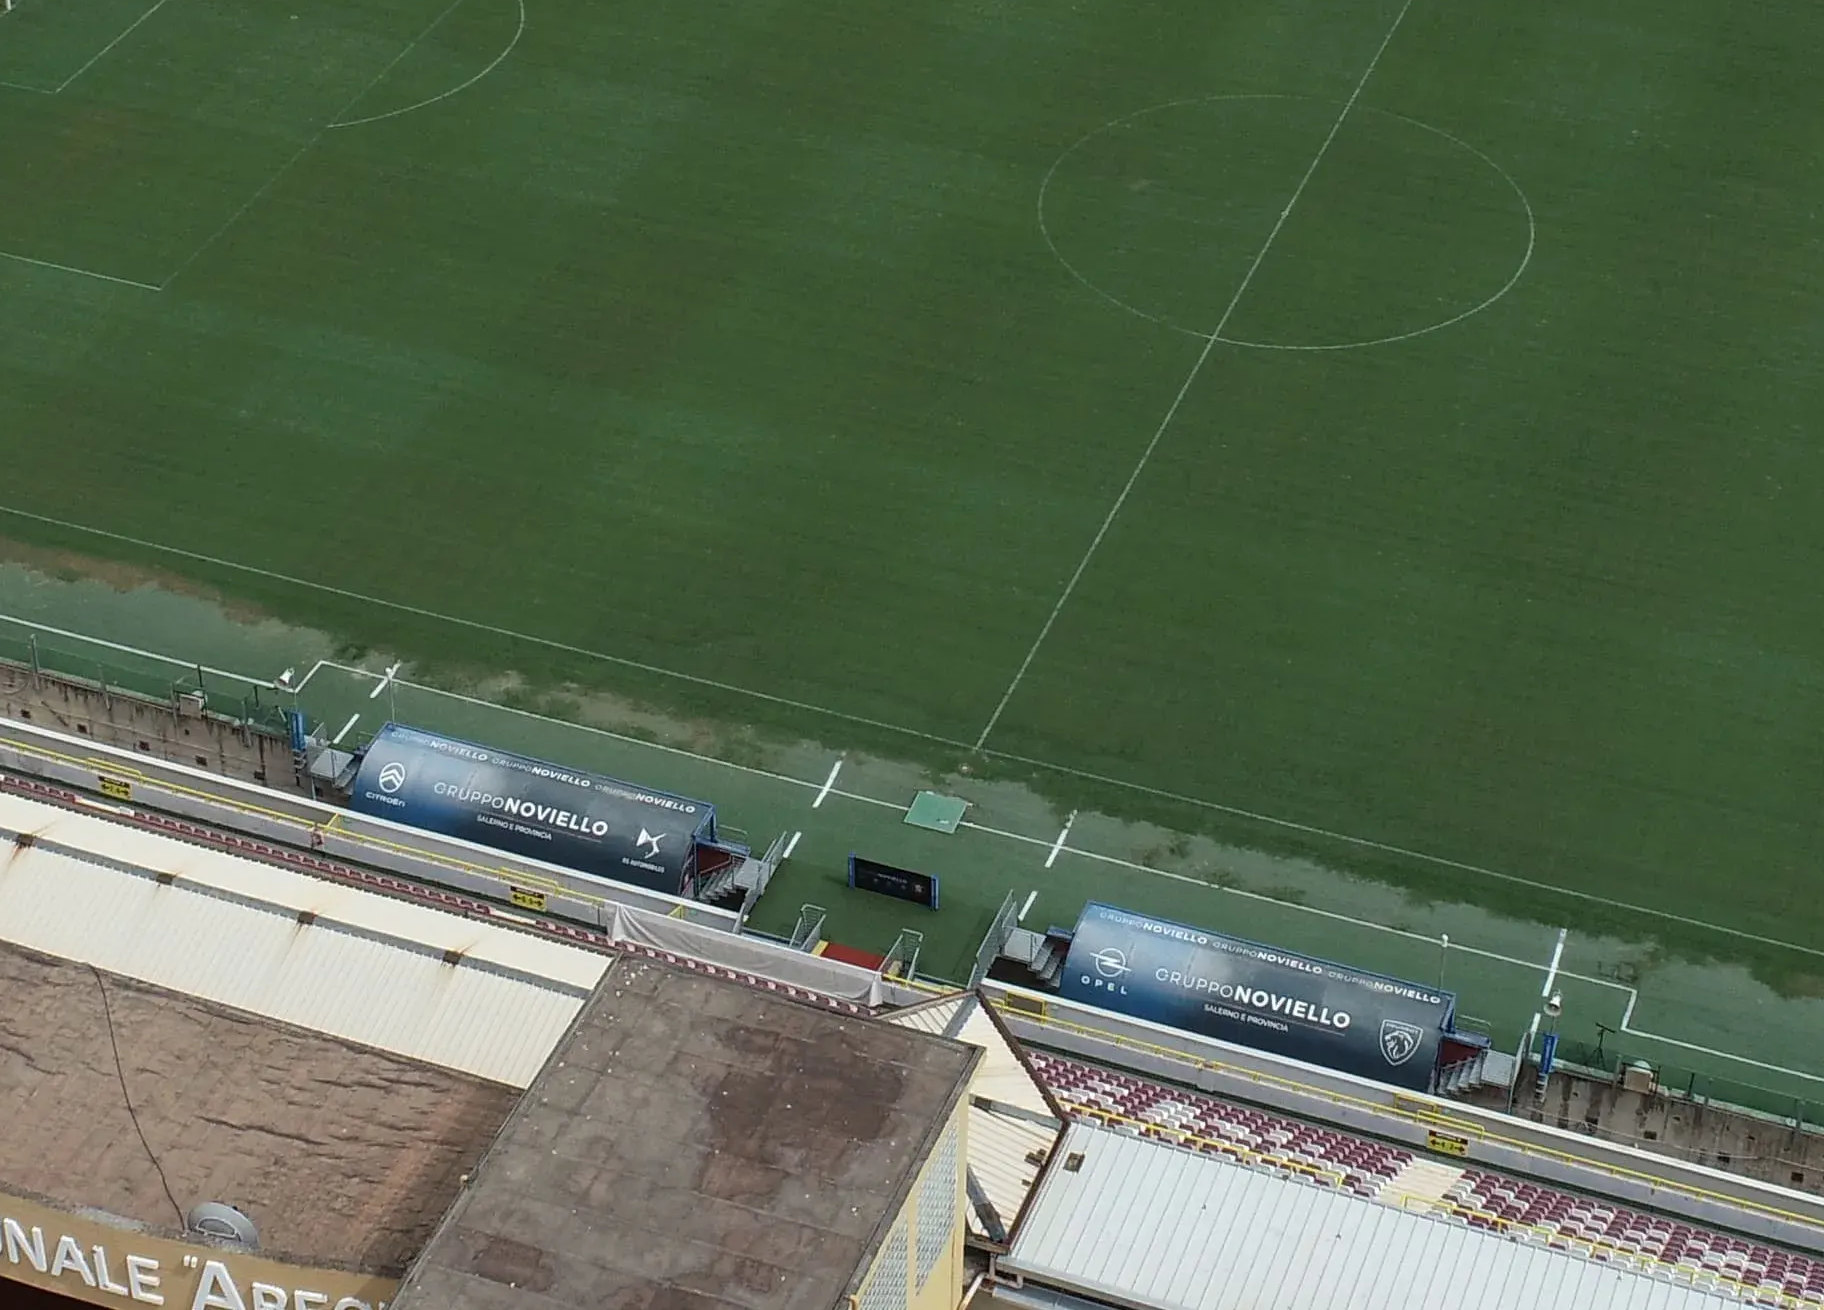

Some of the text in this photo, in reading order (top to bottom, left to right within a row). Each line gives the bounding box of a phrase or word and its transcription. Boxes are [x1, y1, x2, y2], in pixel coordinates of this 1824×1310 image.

[433, 781, 609, 837] GRUPPONOVIELLO
[477, 814, 509, 830] SALERNO
[514, 823, 553, 842] PROVINCIA
[1212, 940, 1323, 976] GRUPPONOVIELLO
[1080, 975, 1128, 996] OPEL
[1155, 967, 1352, 1029] GRUPPONOVIELLO
[1203, 1003, 1241, 1021] SALERNO
[1246, 1013, 1290, 1033] PROVINCIA
